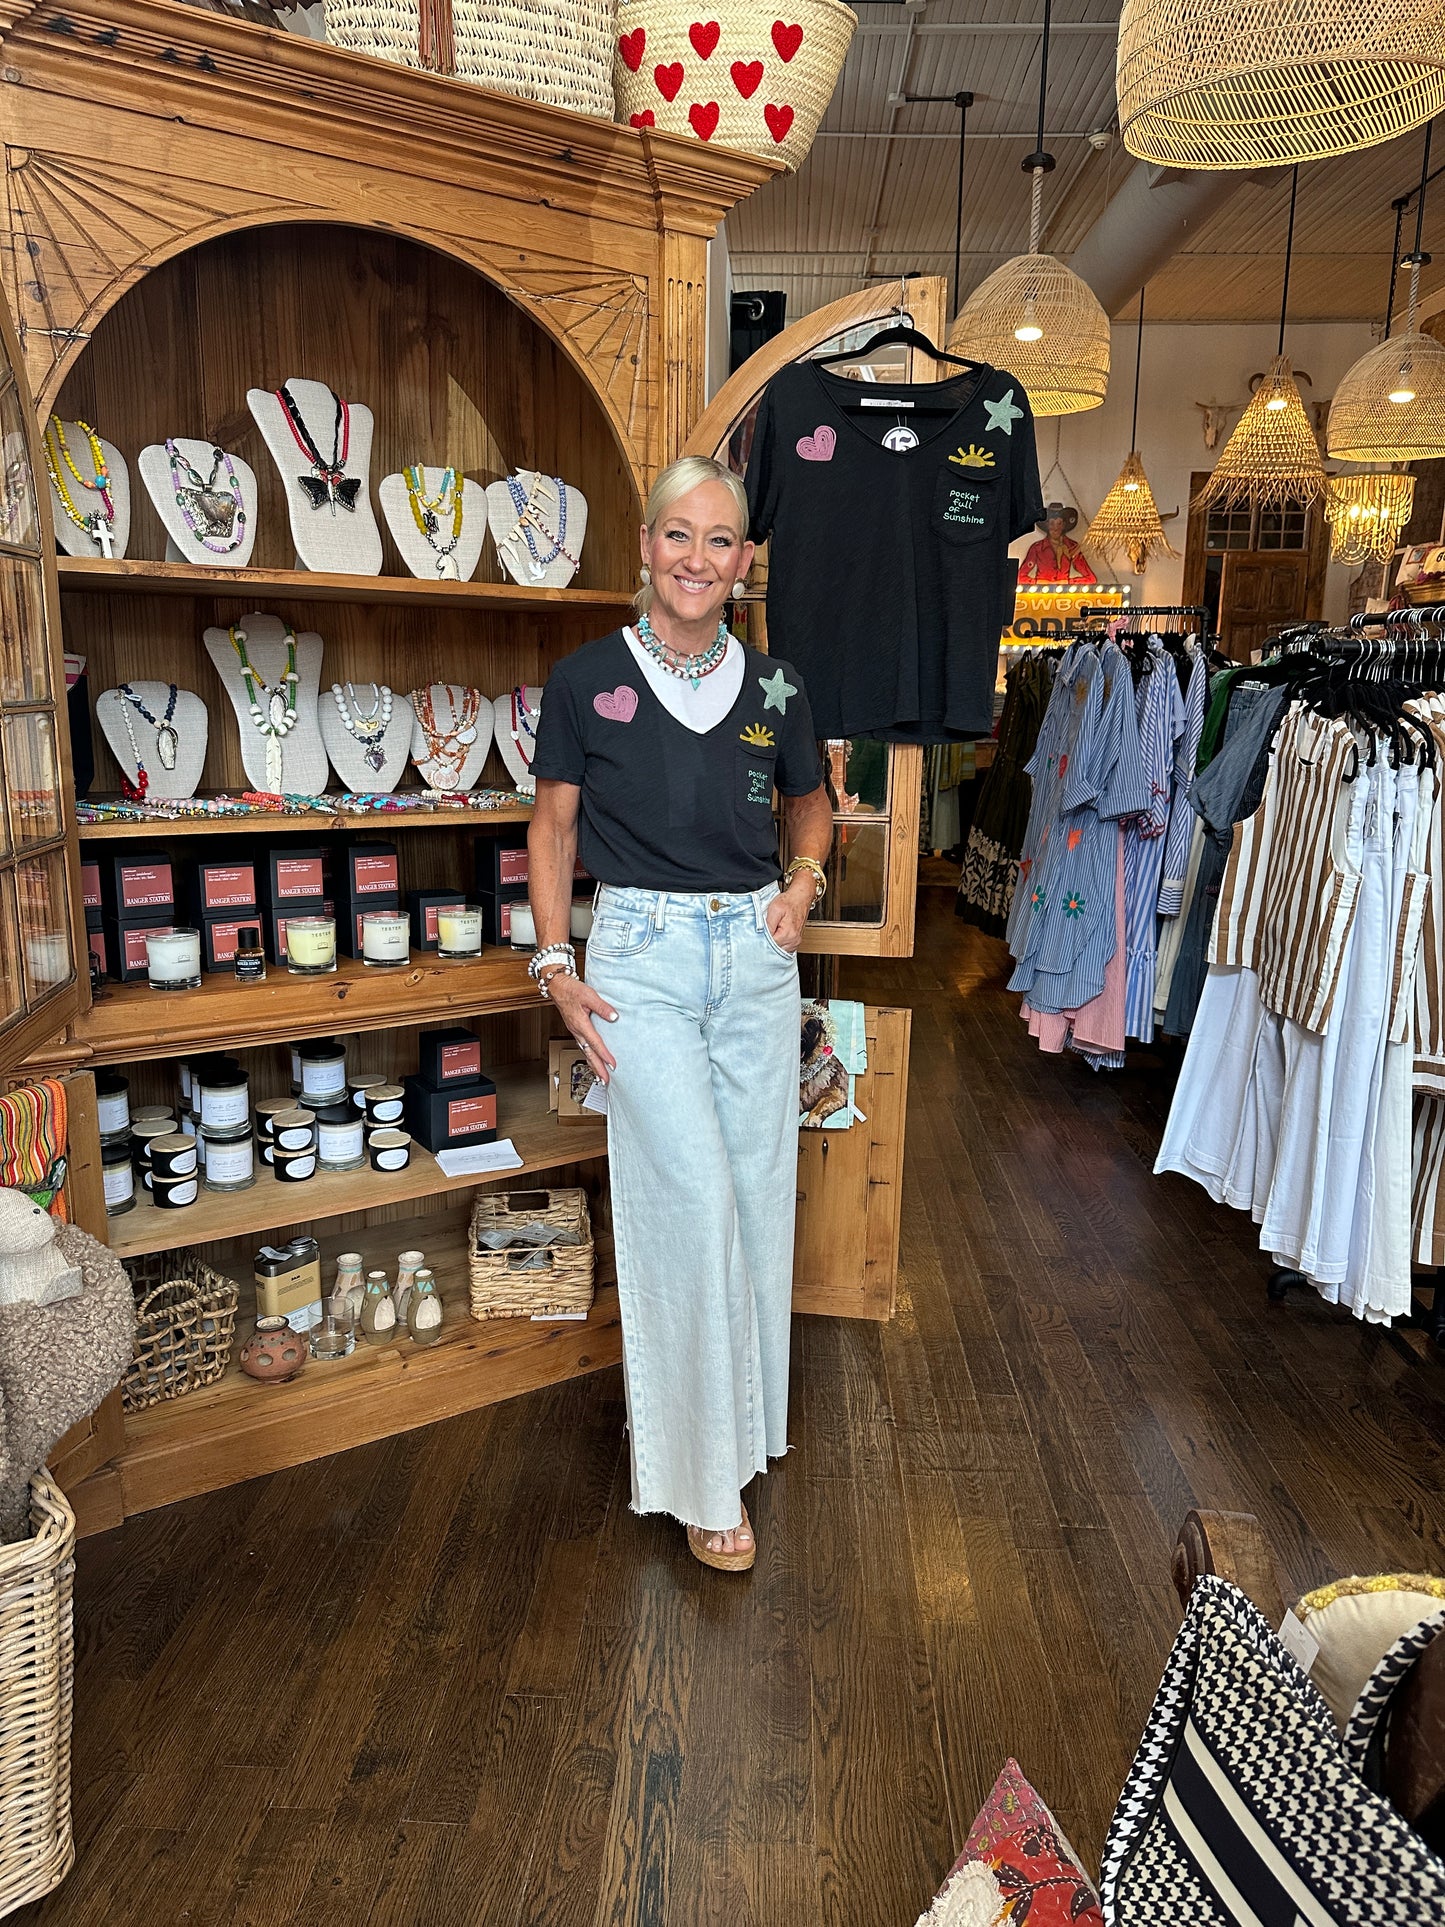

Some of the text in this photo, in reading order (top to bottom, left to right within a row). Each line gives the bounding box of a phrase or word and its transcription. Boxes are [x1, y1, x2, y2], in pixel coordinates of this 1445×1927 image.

[950, 490, 980, 503] pocket
[953, 498, 972, 510] full
[943, 512, 985, 524] Sunshine
[1015, 598, 1117, 611] OWBOY
[126, 897, 149, 905] RANGER
[209, 896, 252, 905] RANGER STATION
[217, 951, 235, 960] RANGE
[130, 959, 148, 968] RANGE
[462, 1066, 478, 1074] STATION
